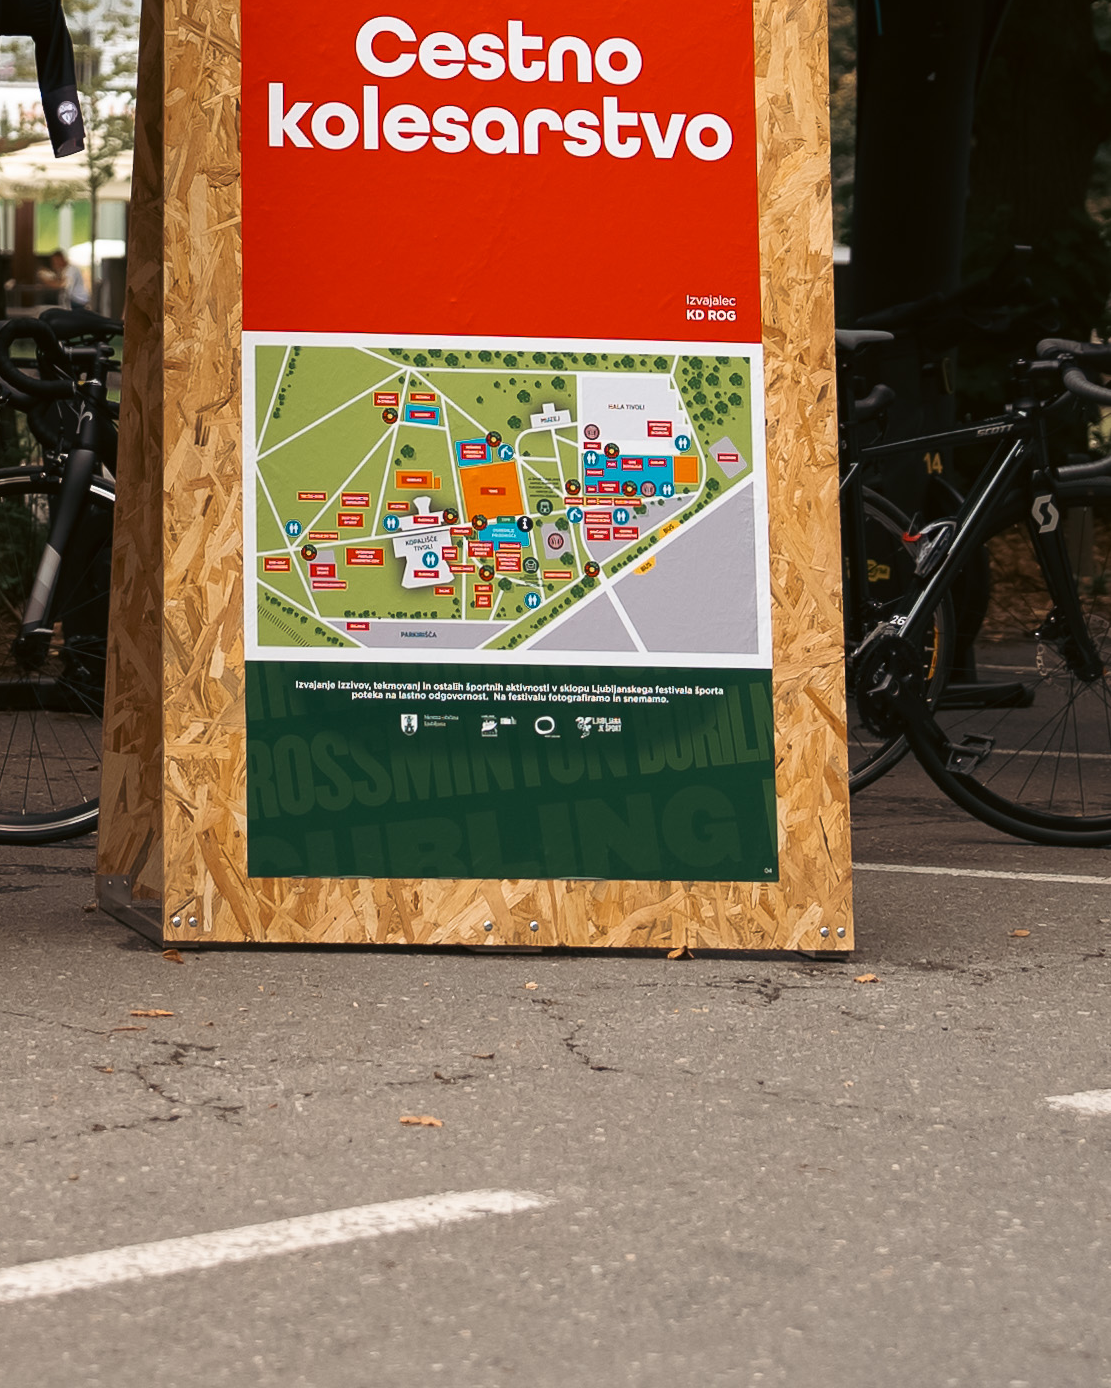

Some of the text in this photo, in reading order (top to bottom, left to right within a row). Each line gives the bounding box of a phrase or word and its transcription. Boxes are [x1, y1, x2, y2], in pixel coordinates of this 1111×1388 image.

[355, 15, 643, 85] Cestno
[268, 82, 733, 162] kolesarstvo
[686, 294, 736, 308] Izvajalec
[686, 309, 737, 322] KD ROG
[976, 423, 1014, 437] SCOTT
[924, 452, 943, 474] 14
